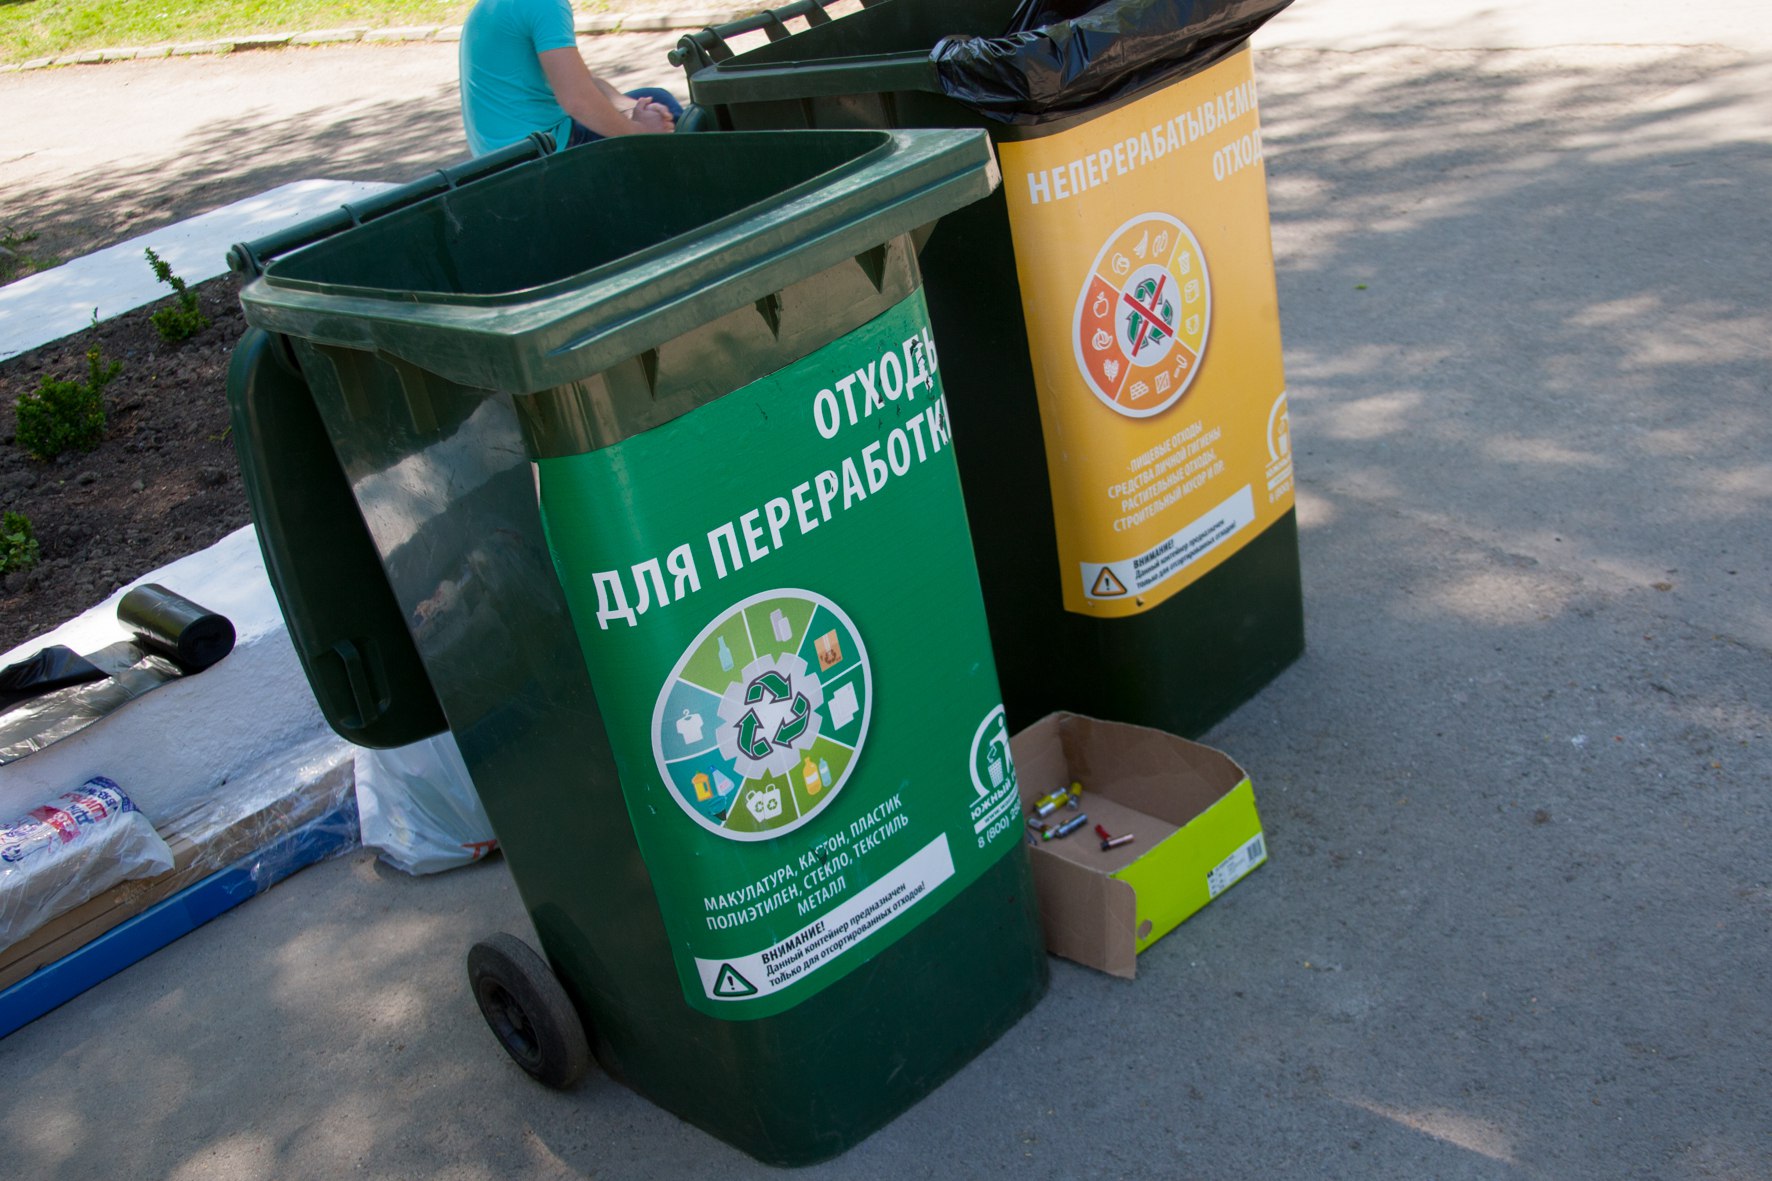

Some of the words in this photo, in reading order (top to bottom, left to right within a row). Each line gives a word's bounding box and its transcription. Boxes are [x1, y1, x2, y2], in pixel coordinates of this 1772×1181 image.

[1108, 468, 1154, 498] СРЕДСТВА
[1122, 468, 1184, 512] РАСТИТЕЛЬНЫЕ
[1113, 485, 1182, 532] СТРОИТЕЛЬНЫЙ
[592, 543, 701, 630] ДЛЯ
[971, 777, 1011, 820] ЮЖНЫЙ
[704, 864, 798, 911] МАКУЛАТУРА,
[850, 793, 902, 838] ПЛАСТИК
[978, 836, 985, 848] 8
[986, 815, 1010, 843] (800)
[706, 883, 802, 930] ПОЛИЭТИЛЕН,
[803, 852, 852, 889] СТЕКЛО,
[852, 814, 909, 857] ТЕКСТИЛЬ
[797, 876, 846, 916] МЕТАЛЛ
[761, 921, 825, 964] ВНИМАНИЕ!
[766, 949, 804, 977] Данный
[804, 922, 849, 954] контейнер
[849, 883, 906, 926] предназначен
[769, 965, 802, 986] только
[803, 954, 819, 971] для
[820, 907, 892, 958] отсортированных
[892, 880, 925, 910] отходов!
